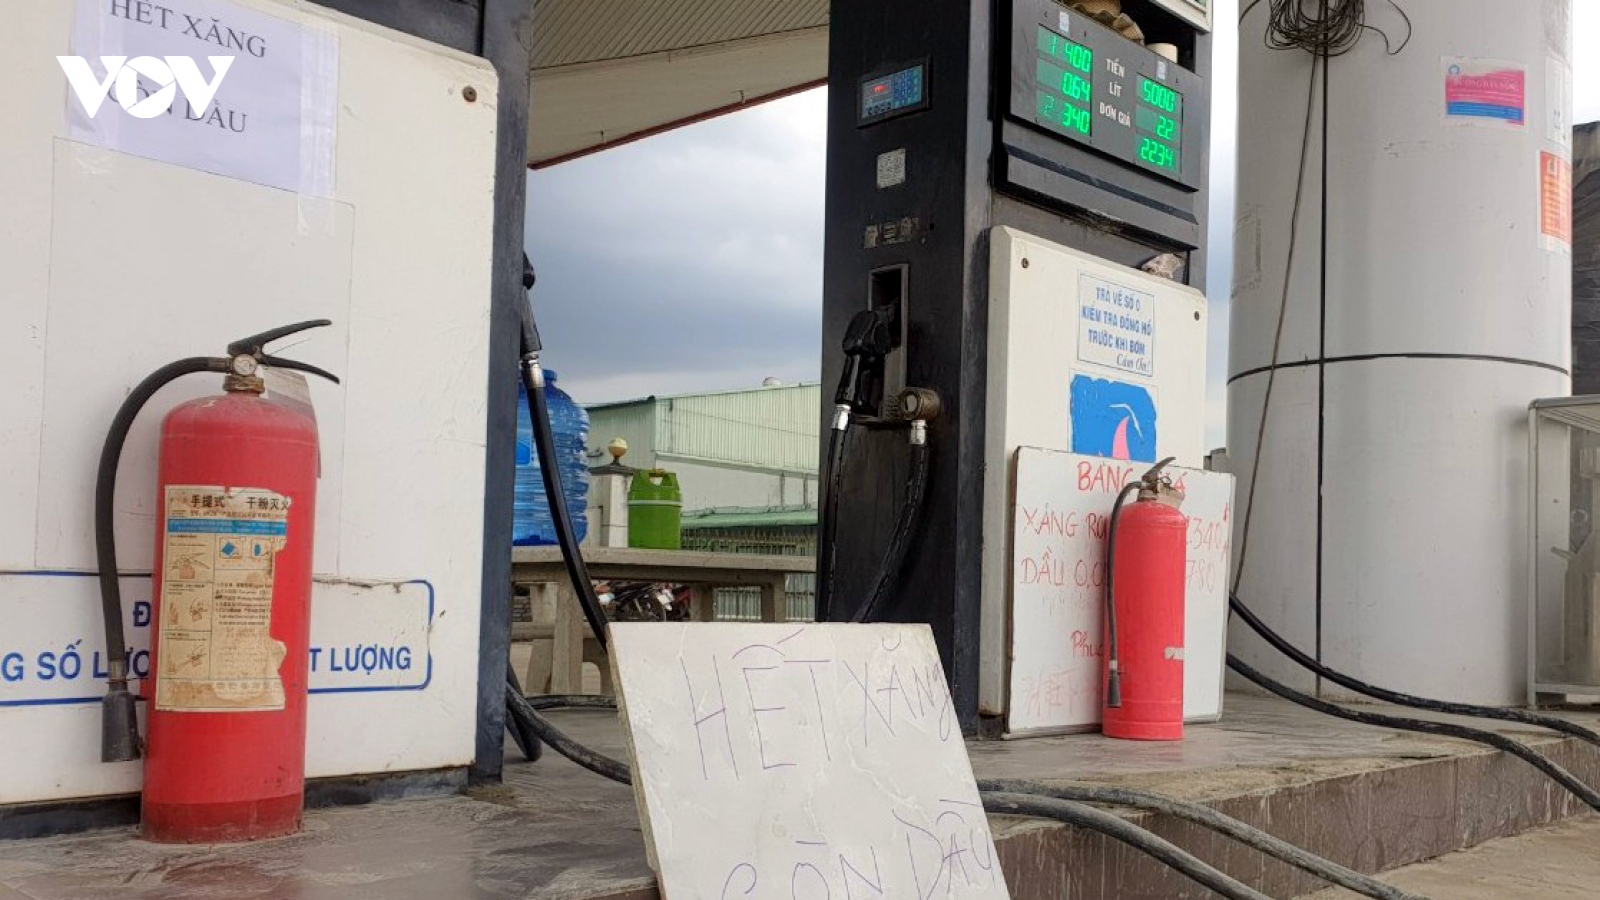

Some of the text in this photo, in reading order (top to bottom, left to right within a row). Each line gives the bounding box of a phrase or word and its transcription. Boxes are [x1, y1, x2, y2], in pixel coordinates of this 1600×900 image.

[182, 14, 267, 58] XĂNG
[1103, 310, 1118, 328] TRA
[1115, 335, 1128, 351] KHI
[37, 639, 82, 680] SỐ
[330, 643, 411, 675] LƯỢNG
[680, 628, 831, 780] HẾT
